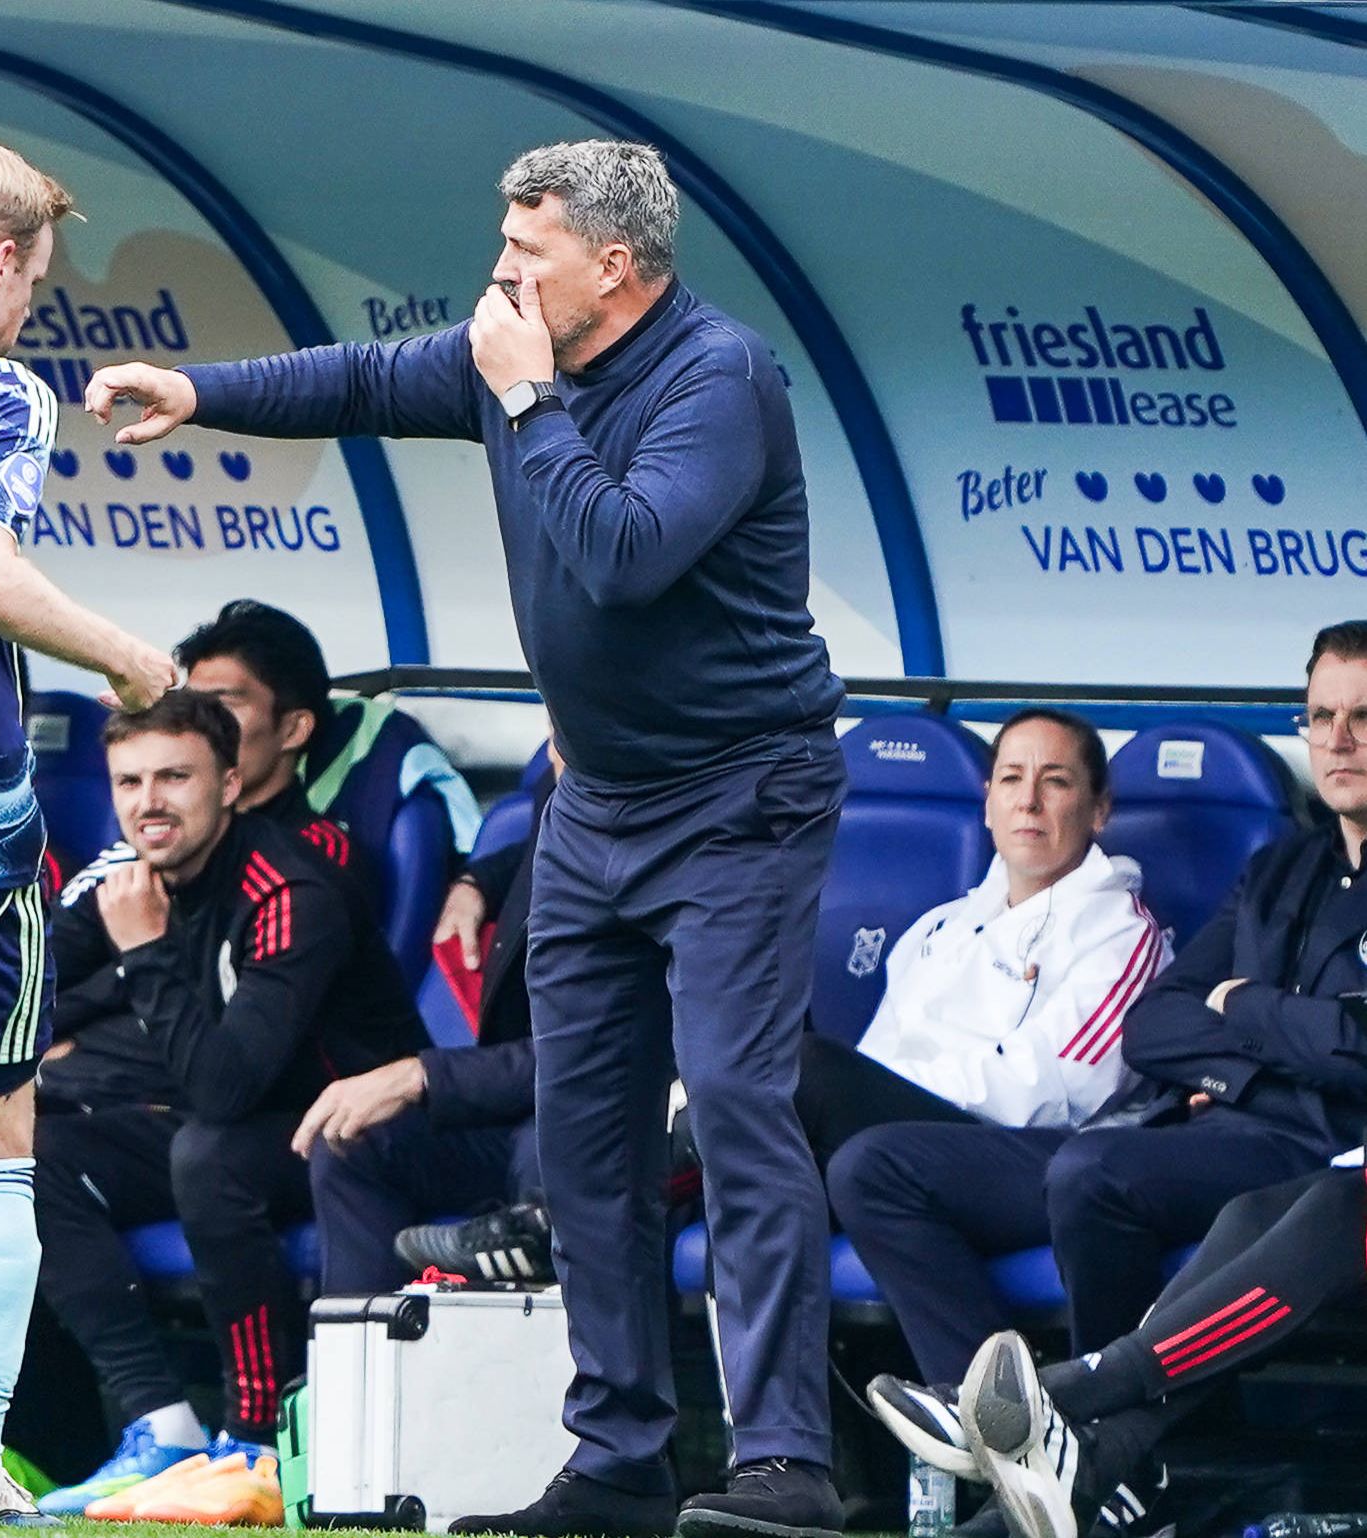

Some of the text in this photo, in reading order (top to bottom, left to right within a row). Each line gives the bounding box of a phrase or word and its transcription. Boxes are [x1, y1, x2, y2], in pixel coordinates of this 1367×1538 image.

[362, 293, 449, 338] Beter
[961, 303, 1227, 371] friesland
[956, 465, 1049, 521] Beter
[32, 502, 341, 552] AN DEN BRUG
[1020, 524, 1367, 577] VAN DEN BRUG
